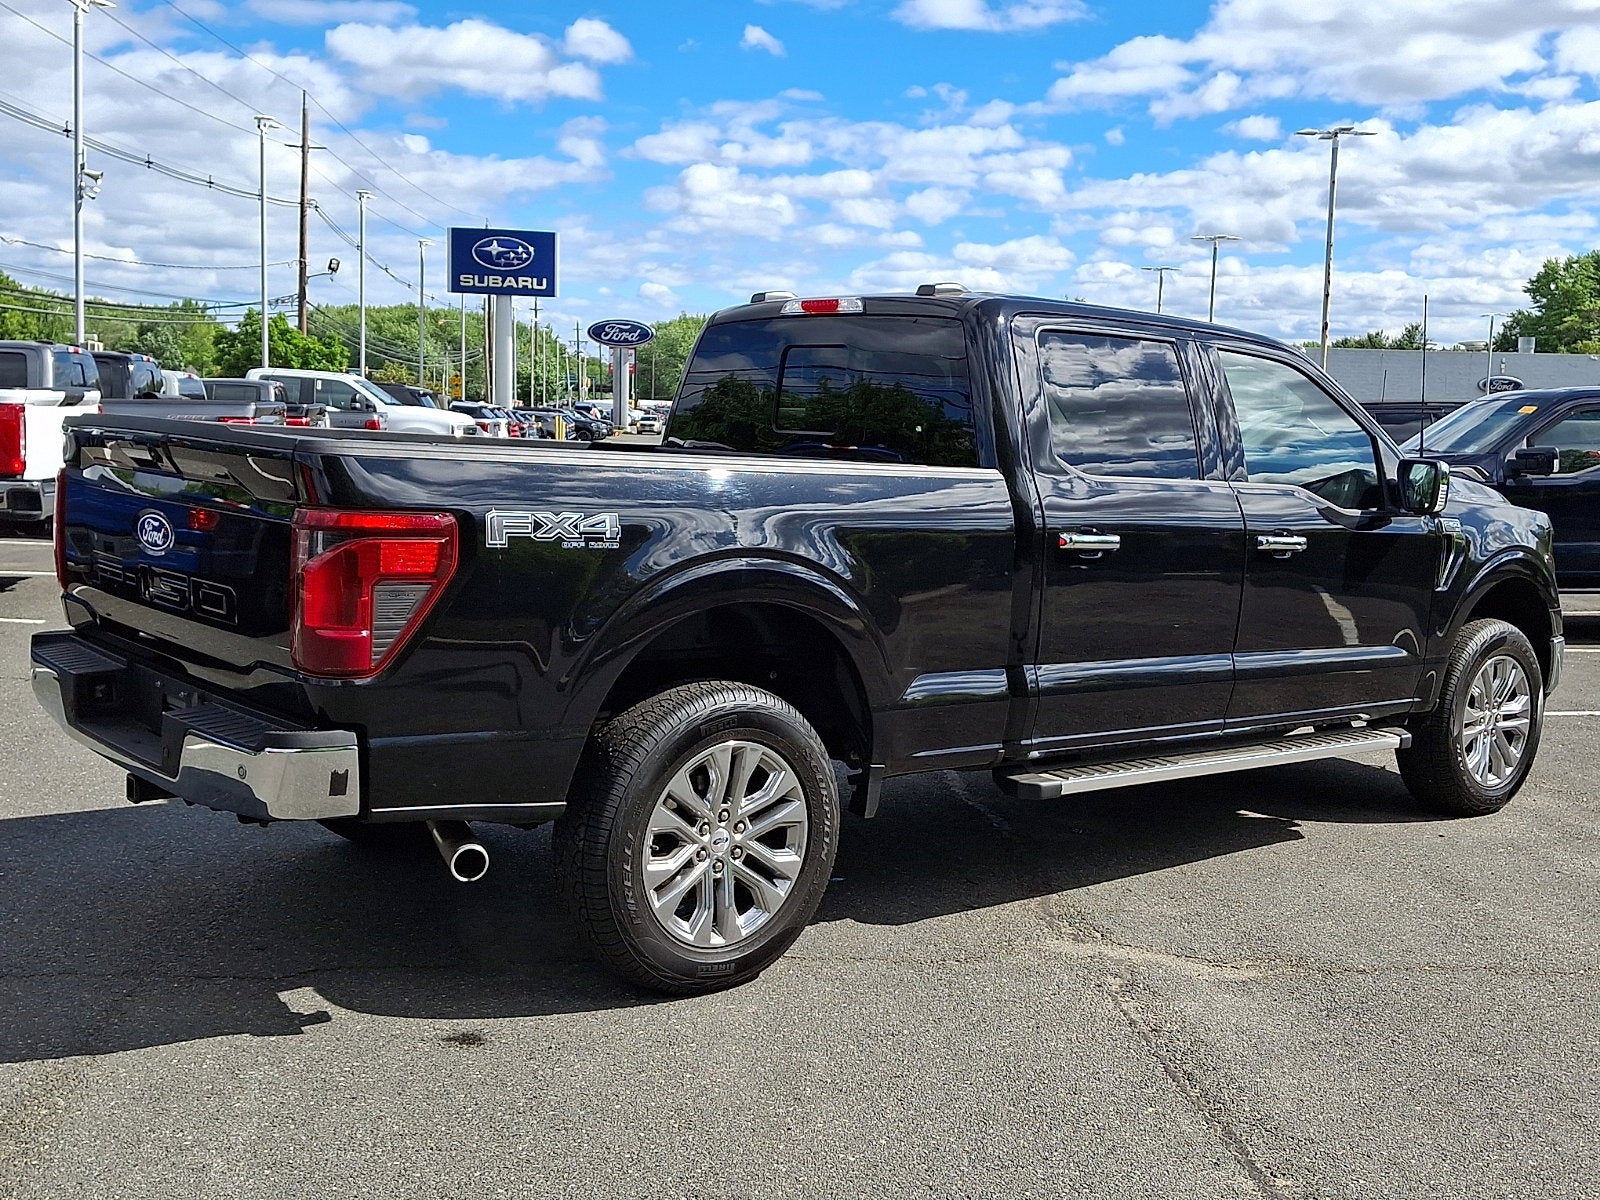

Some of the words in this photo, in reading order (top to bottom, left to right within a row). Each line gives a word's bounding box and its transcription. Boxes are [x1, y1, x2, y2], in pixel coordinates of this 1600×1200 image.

[459, 274, 547, 290] SUBARU
[601, 323, 640, 342] Ford
[142, 517, 168, 546] Ford
[485, 509, 622, 548] FX4
[561, 541, 586, 549] OFF
[802, 748, 832, 862] SCORPION
[622, 830, 642, 926] PIRELLI
